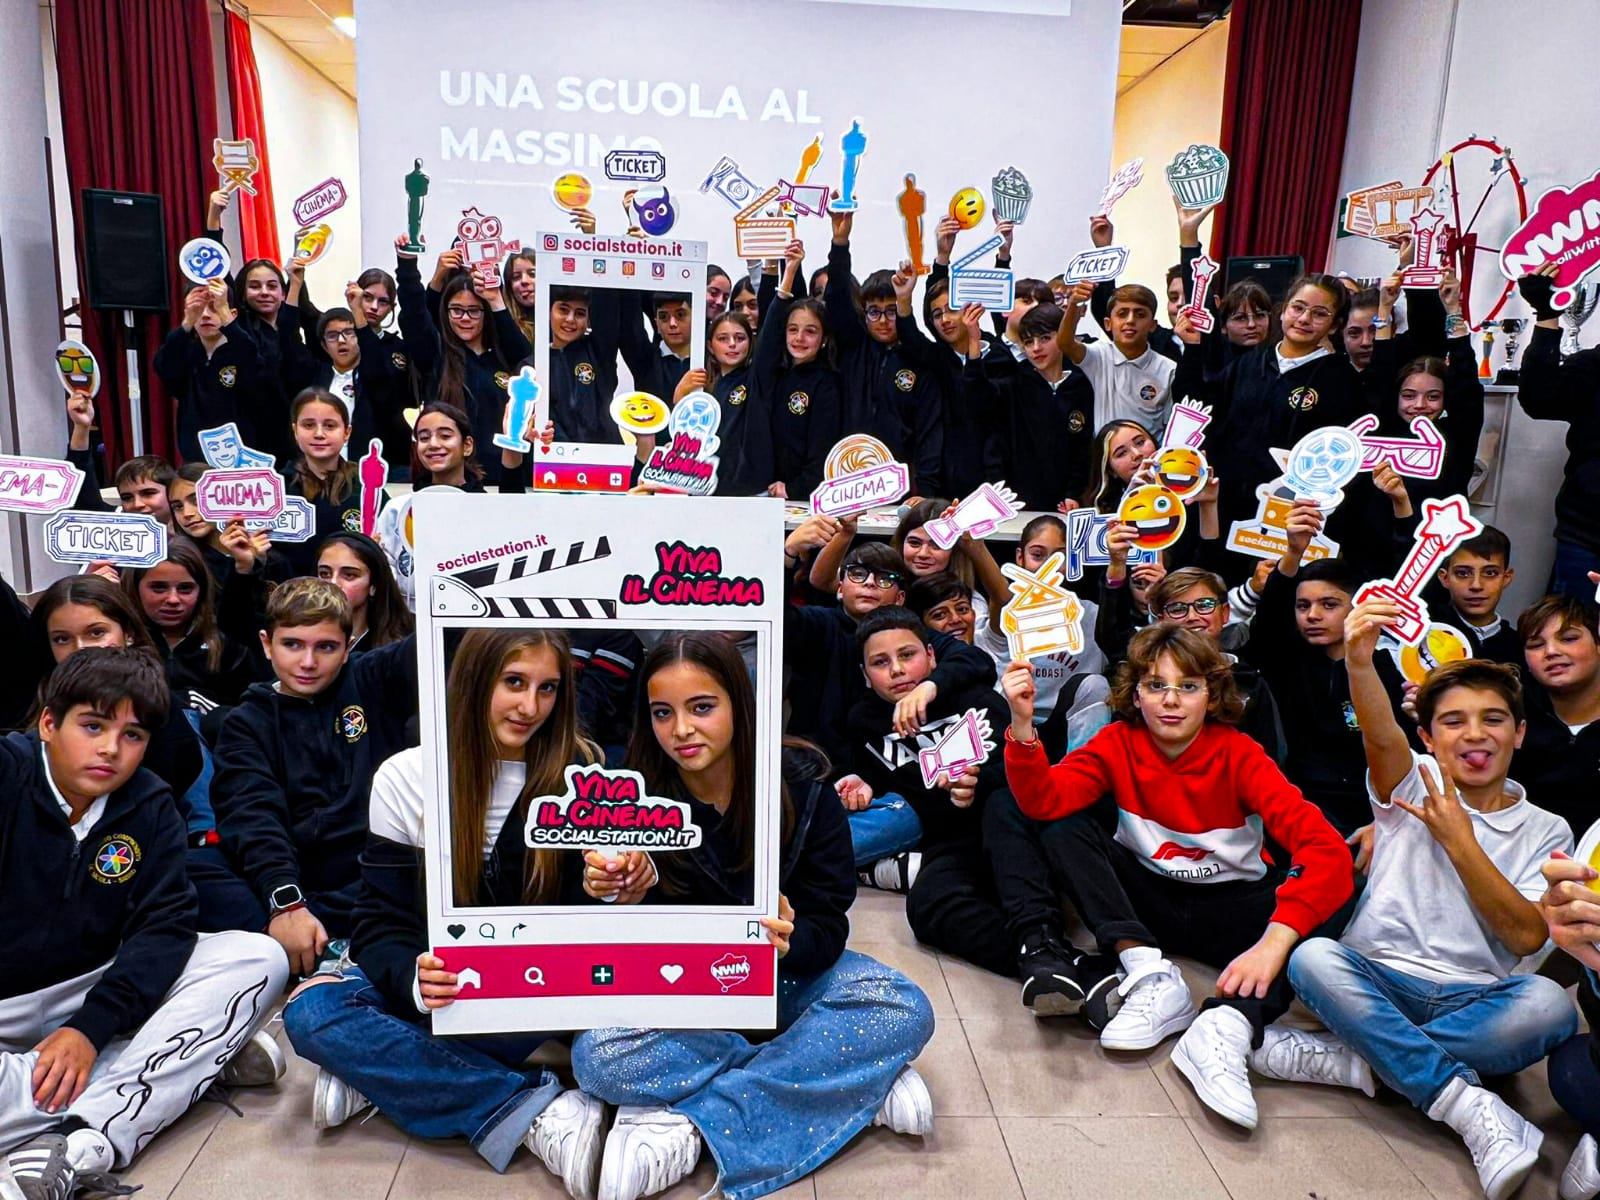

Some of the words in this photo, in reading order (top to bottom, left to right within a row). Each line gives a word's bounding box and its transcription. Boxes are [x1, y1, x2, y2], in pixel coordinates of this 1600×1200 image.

[440, 70, 544, 110] UNA
[557, 78, 748, 121] SCUOLA
[760, 88, 821, 124] AL
[614, 157, 658, 174] TICKET
[564, 237, 683, 257] socialstation.it
[1077, 256, 1118, 274] TICKET
[67, 525, 149, 552] TICKET
[437, 534, 548, 572] socialstation.it
[1035, 667, 1064, 677] COAST
[712, 962, 749, 977] NWM
